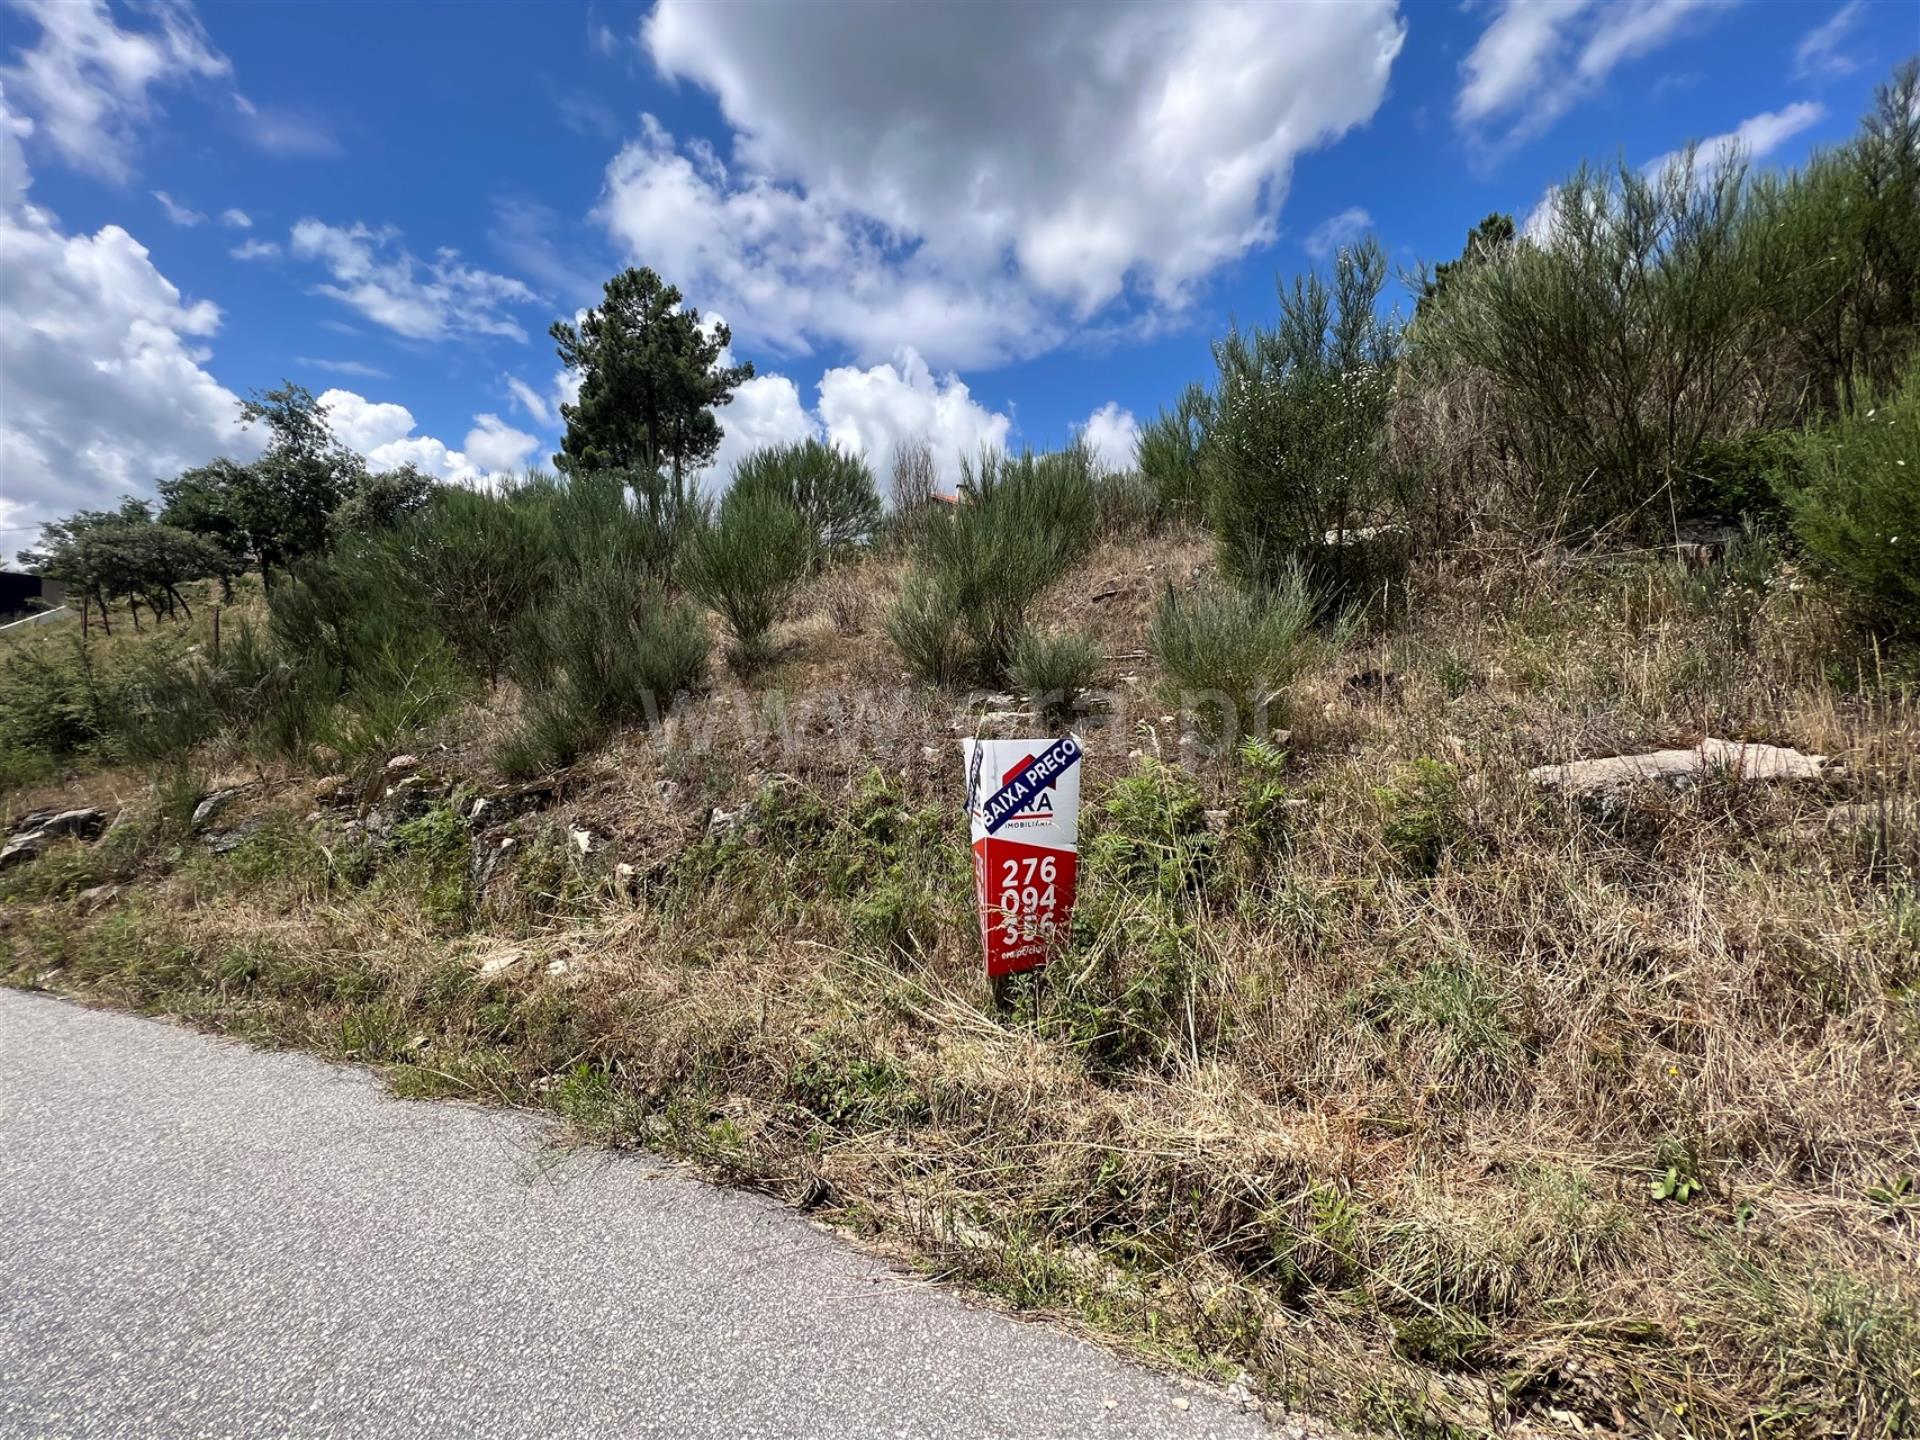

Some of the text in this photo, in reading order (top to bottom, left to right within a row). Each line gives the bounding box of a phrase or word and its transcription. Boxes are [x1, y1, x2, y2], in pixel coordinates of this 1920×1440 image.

[983, 782, 1029, 827] BAIXA
[1025, 740, 1076, 787] PREÇO
[1002, 856, 1057, 887] 276
[1001, 885, 1057, 914] 094
